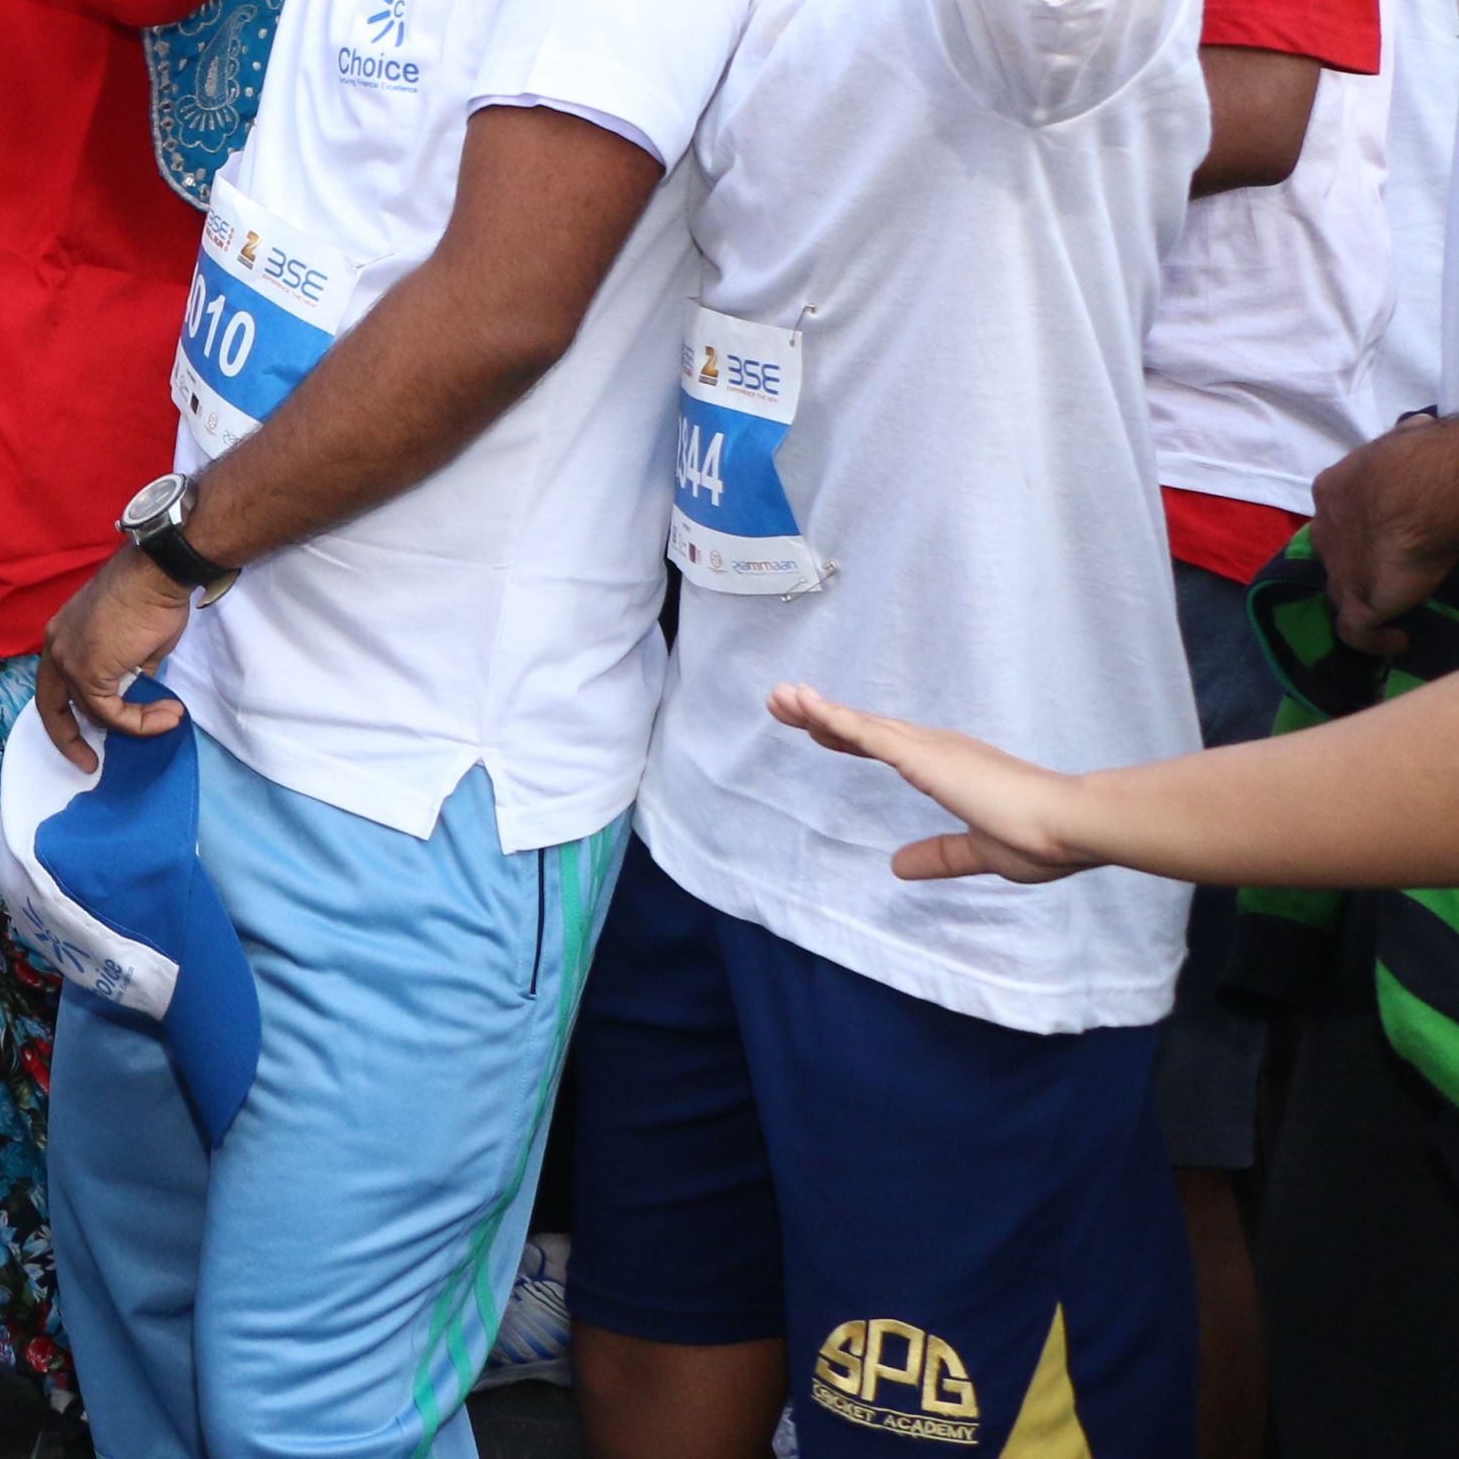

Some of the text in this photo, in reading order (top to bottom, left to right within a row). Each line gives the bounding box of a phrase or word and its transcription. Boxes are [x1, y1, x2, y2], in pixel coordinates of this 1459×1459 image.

[338, 47, 419, 83] Choice
[186, 263, 255, 377] 010
[95, 958, 122, 998] oice
[815, 1318, 979, 1418] SPG
[813, 1383, 975, 1441] CRICKET ACADEMY
